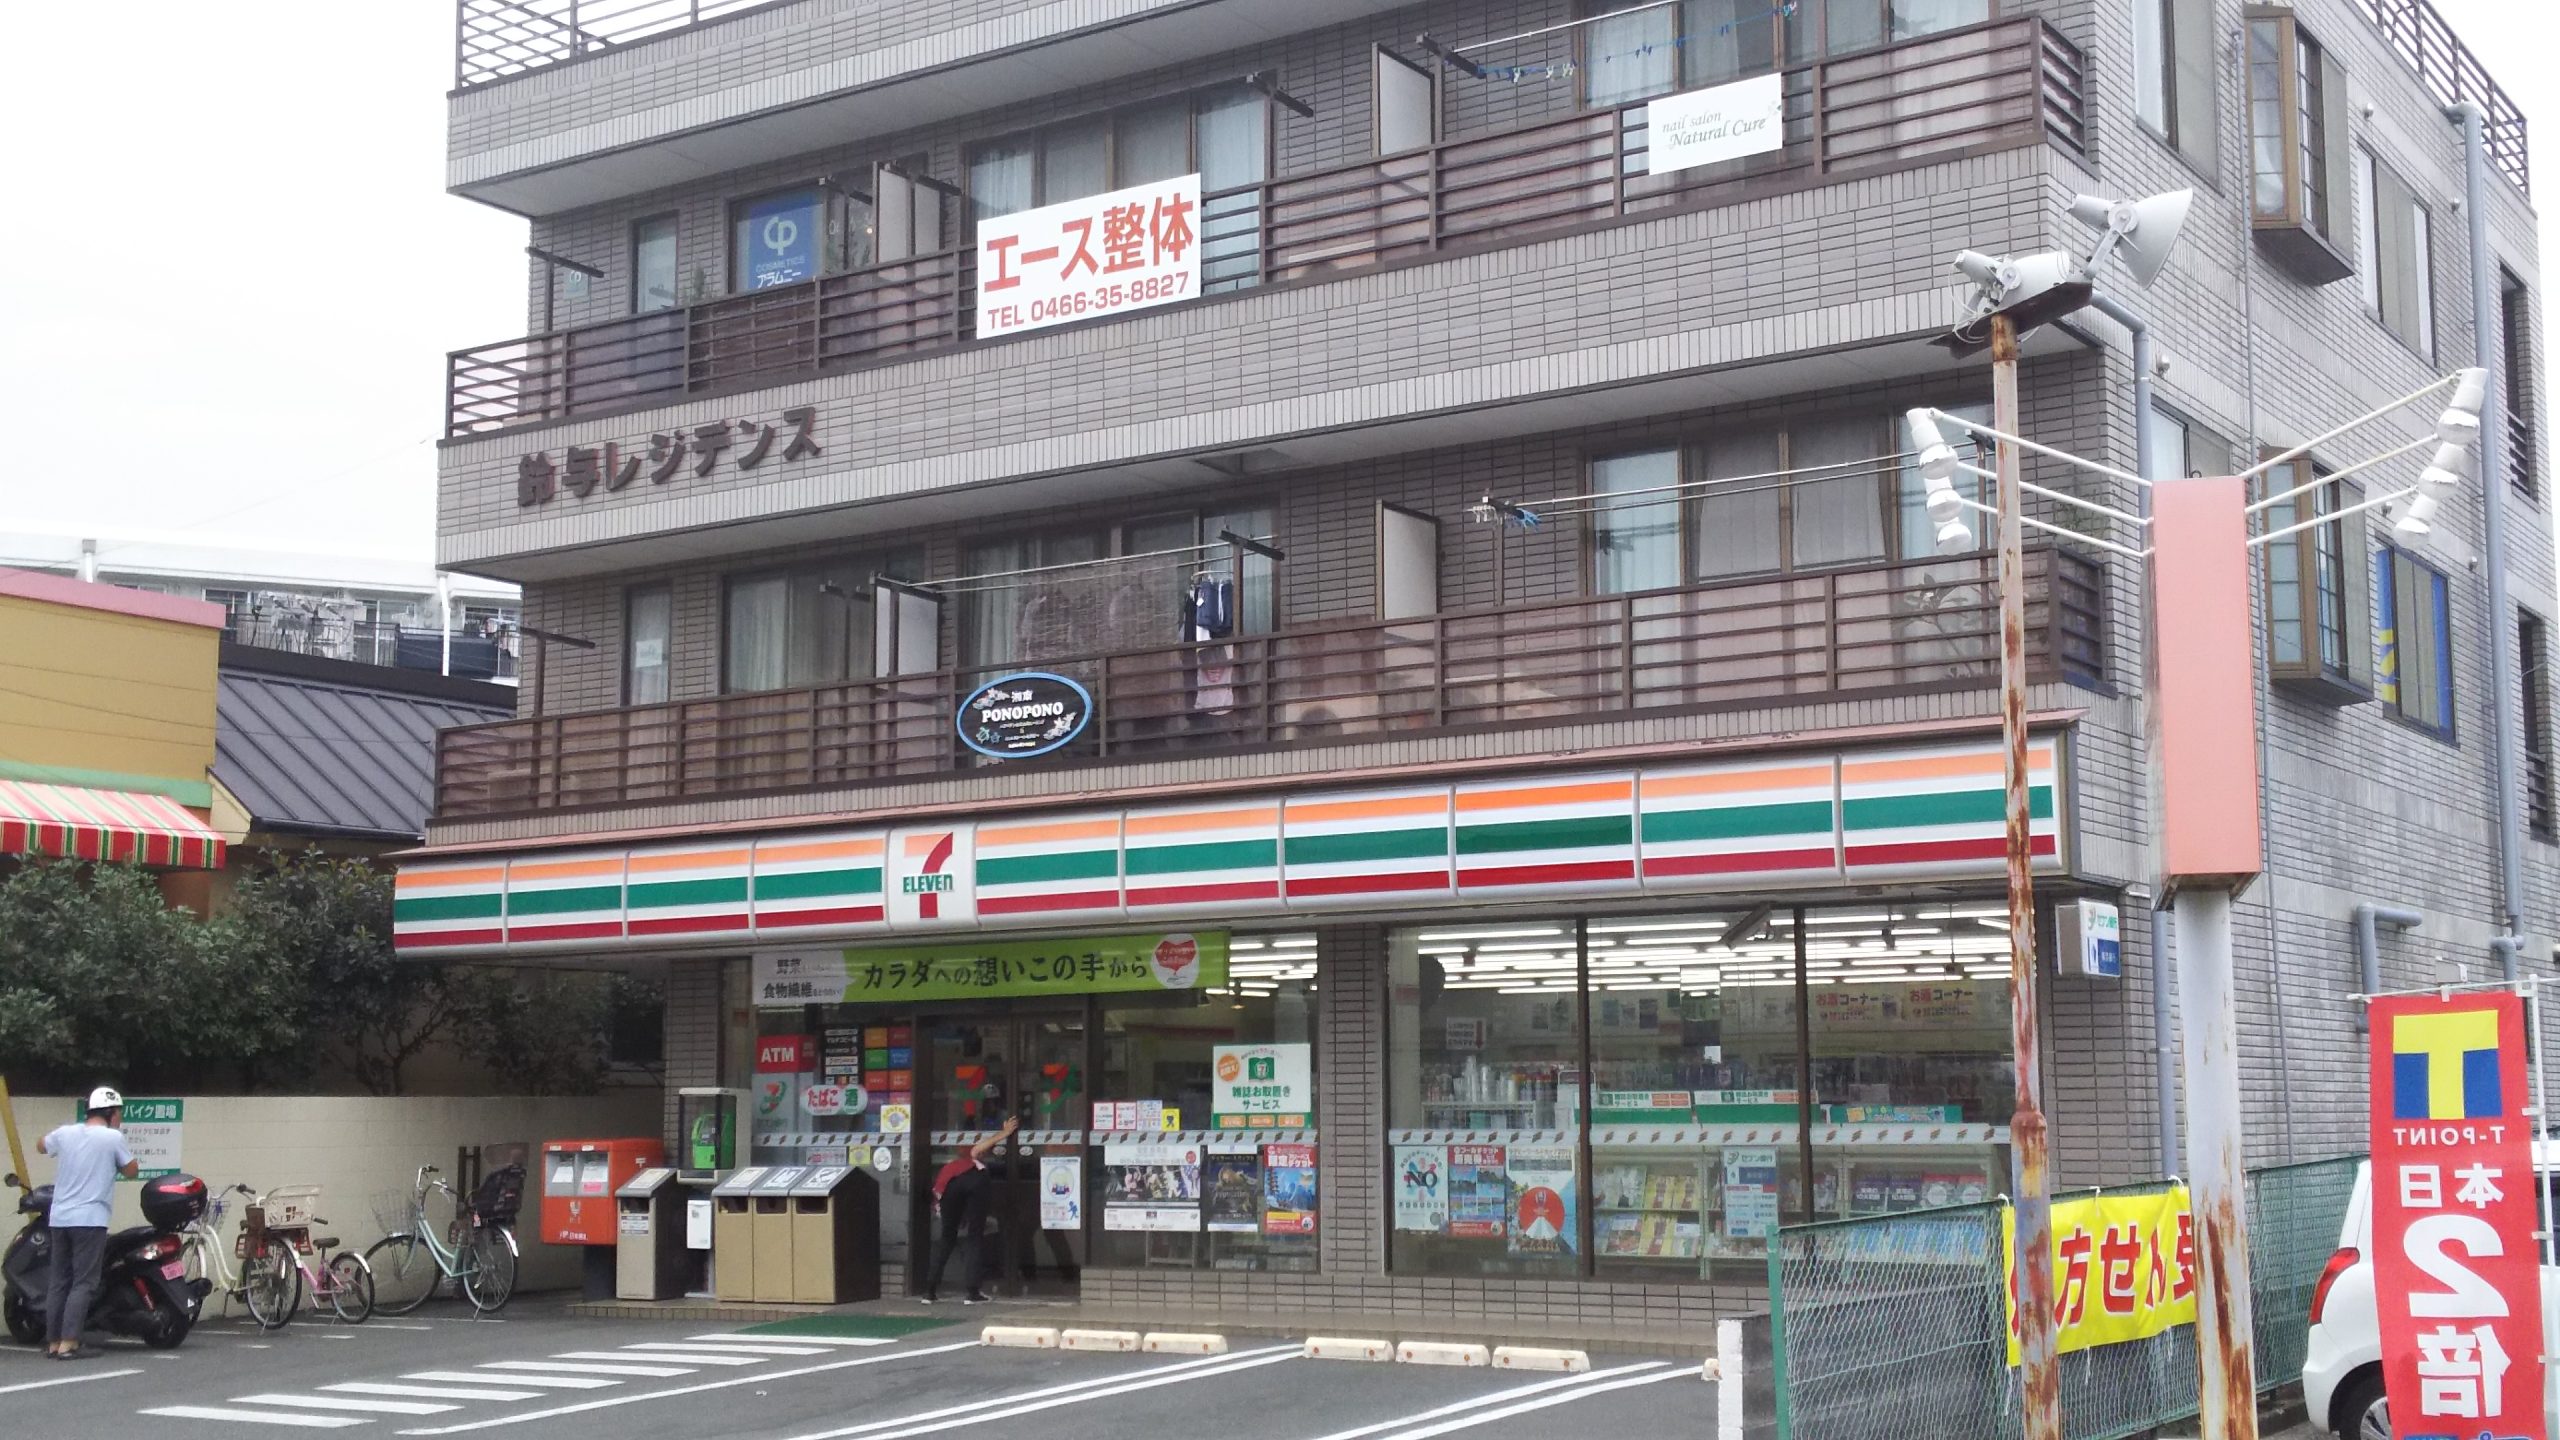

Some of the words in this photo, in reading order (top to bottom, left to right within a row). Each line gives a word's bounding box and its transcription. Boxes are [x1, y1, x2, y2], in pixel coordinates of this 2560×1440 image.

[1663, 116, 1685, 133] nail
[1691, 111, 1721, 127] salon
[1670, 121, 1727, 146] Natural
[1733, 118, 1765, 136] Cure
[984, 192, 1194, 293] エース整体
[756, 268, 802, 289] アラムニー
[987, 302, 1025, 330] TEL
[1031, 270, 1189, 322] 0466-35-8827
[981, 701, 1064, 723] PONOPONO
[864, 952, 1147, 990] カラダへの想いこの手から
[761, 1047, 795, 1063] ATM
[807, 1088, 839, 1108] たばこ
[1242, 1099, 1281, 1110] サービス
[123, 1104, 176, 1119] バイク置場
